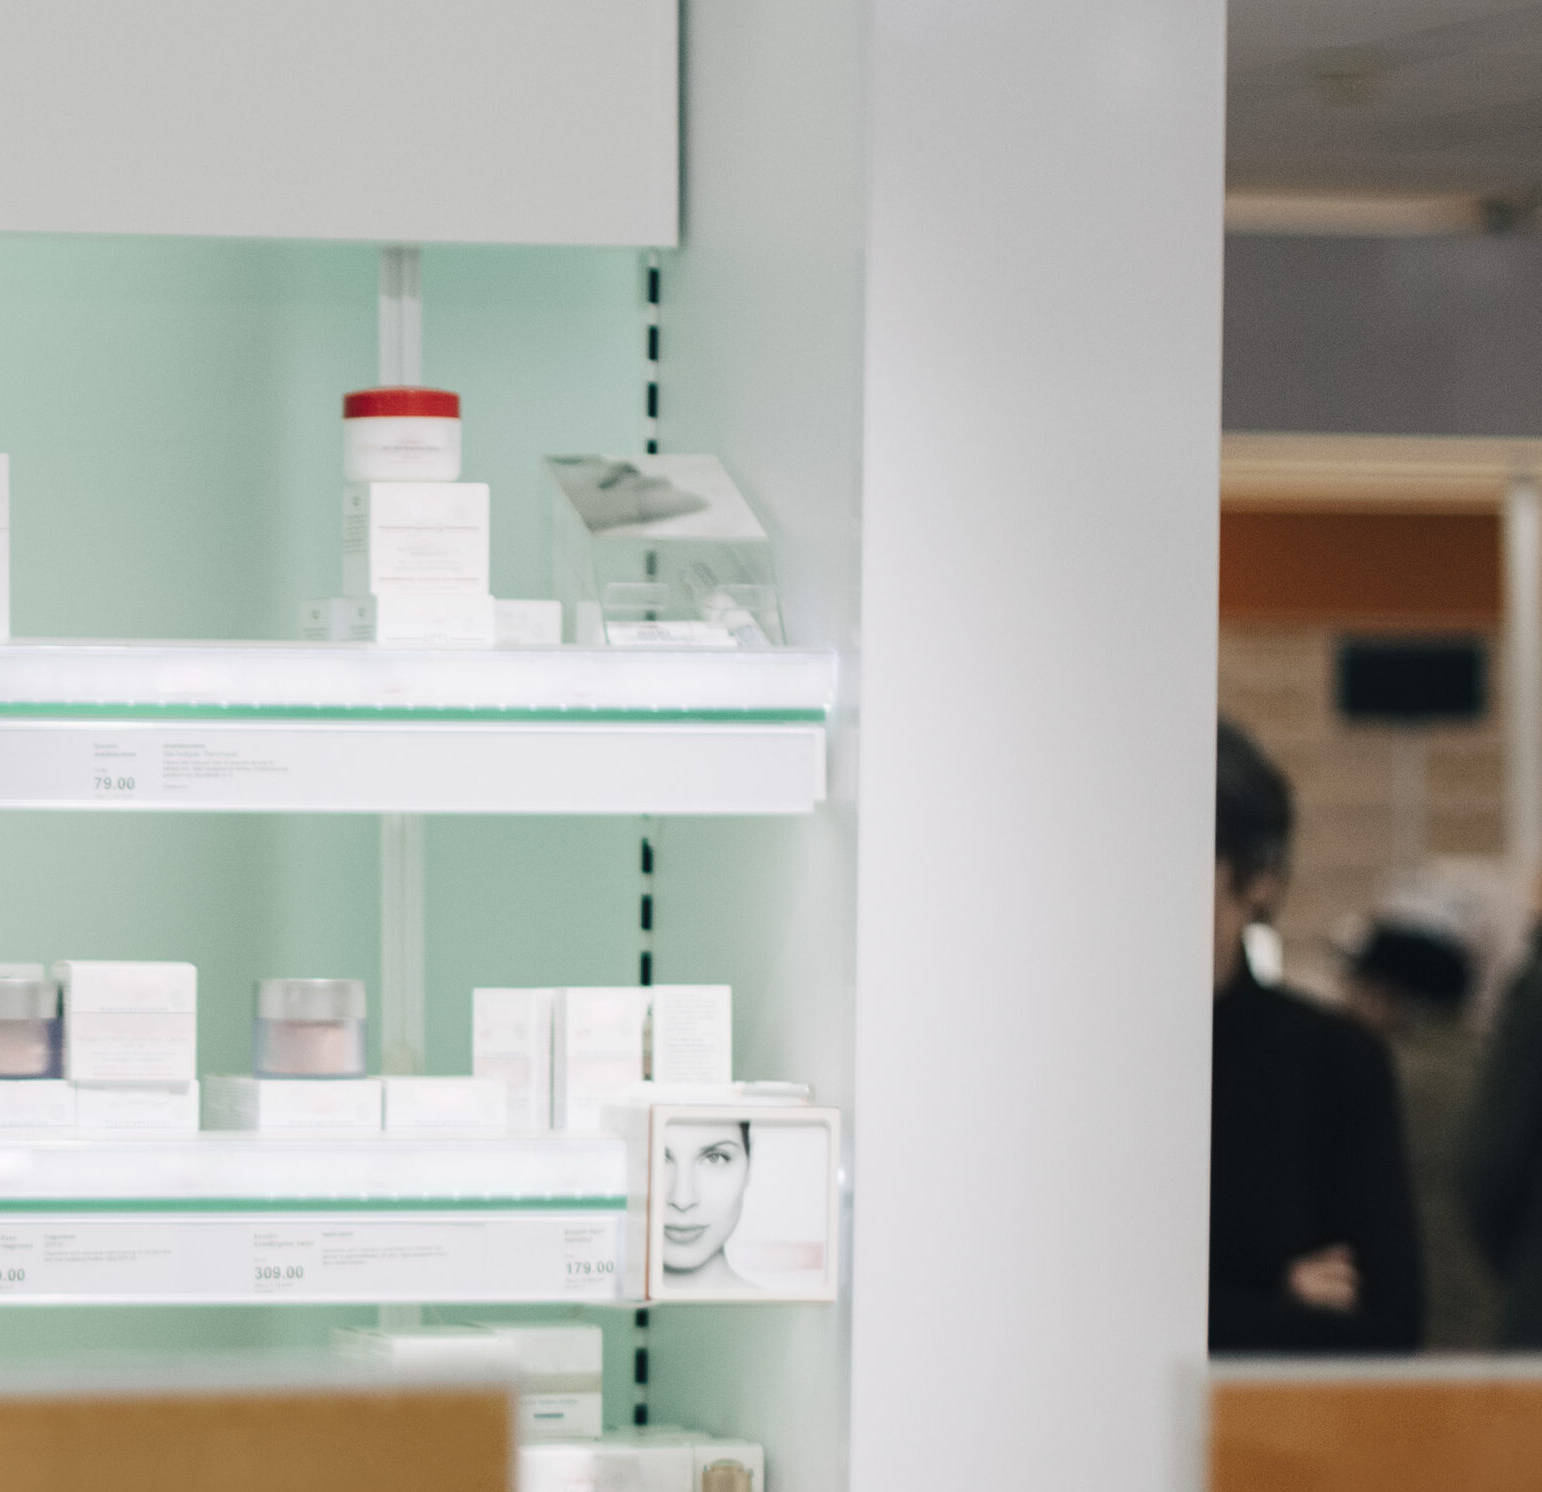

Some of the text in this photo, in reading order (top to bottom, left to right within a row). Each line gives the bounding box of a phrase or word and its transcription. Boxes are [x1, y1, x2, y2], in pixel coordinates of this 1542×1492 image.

[94, 776, 136, 791] 79.00
[254, 1265, 304, 1281] 309.00
[566, 1260, 614, 1275] 179.00
